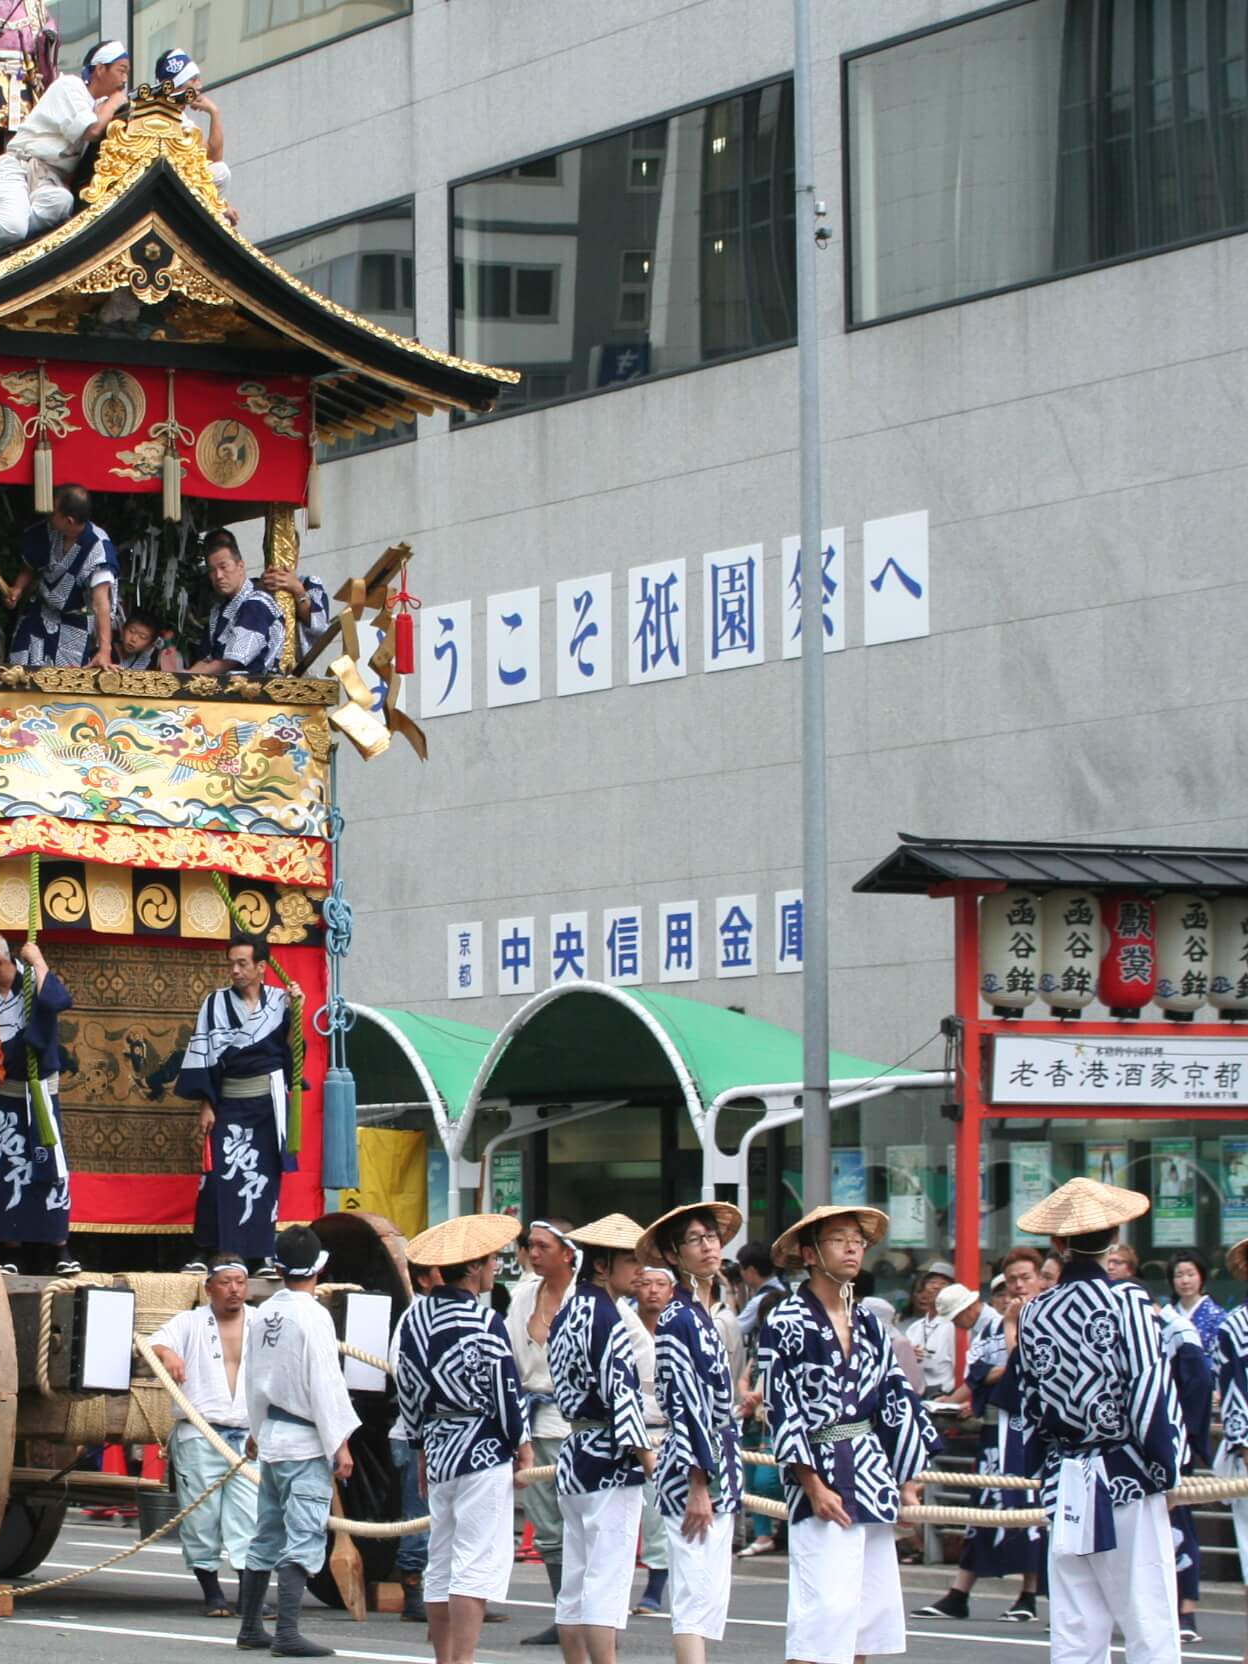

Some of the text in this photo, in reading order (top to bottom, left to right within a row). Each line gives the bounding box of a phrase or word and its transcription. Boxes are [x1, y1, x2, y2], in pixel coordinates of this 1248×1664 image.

[457, 930, 472, 989] 京都
[500, 899, 804, 986] 中央信用金庫
[1008, 1059, 1243, 1090] 老香港酒家京都
